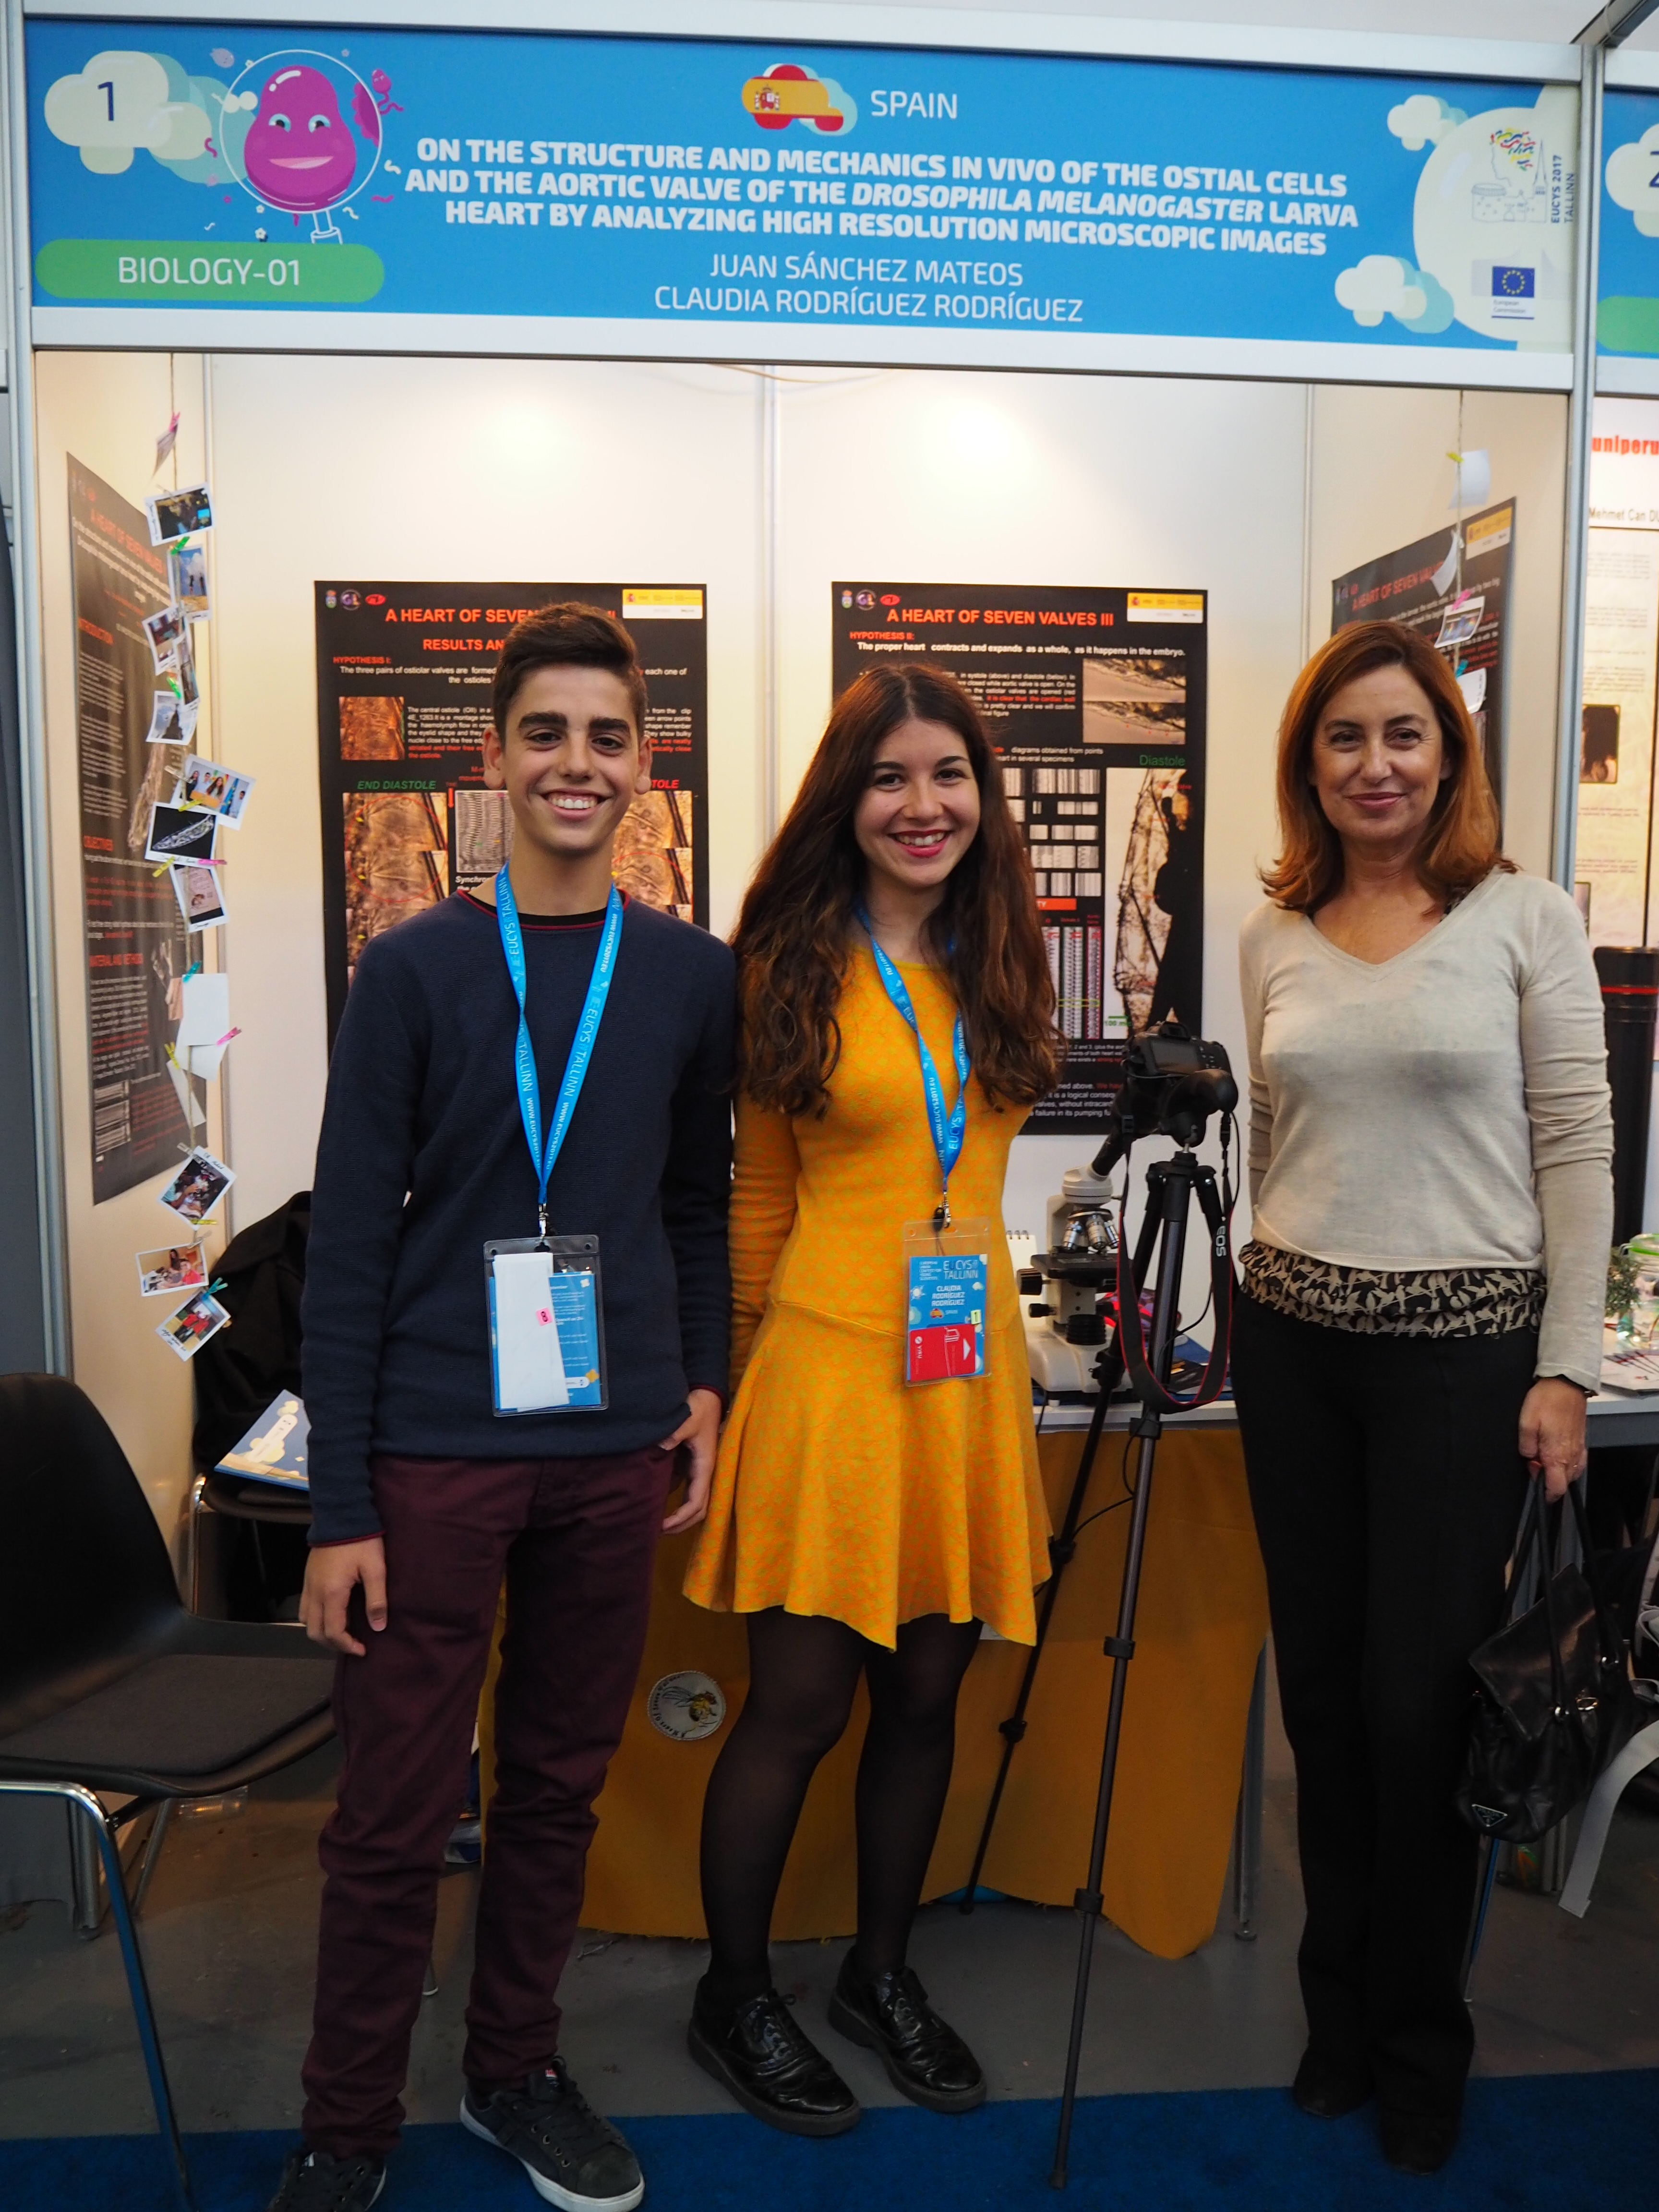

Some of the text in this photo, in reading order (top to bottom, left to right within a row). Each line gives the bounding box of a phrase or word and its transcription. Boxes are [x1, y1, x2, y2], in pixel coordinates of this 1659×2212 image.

[96, 81, 116, 122] 1
[871, 91, 957, 119] SPAIN
[418, 138, 1346, 197] ON THE STRUCTURE AND MECHANICS IN VIVO OF THE OSTIAL CELLS
[405, 169, 1358, 227] AND THE AORTIC VALVE OF THE DROSOPHILA MELANOGASTER LARVA
[1551, 155, 1562, 223] EUCYS 2017
[1564, 172, 1575, 223] TALLINN
[446, 201, 1326, 255] HEART BY ANALYZING HIGH RESOLUTION MICROSCOPIC IMAGES
[118, 256, 301, 287] BIOLOGY-01
[710, 251, 1022, 286] JUAN SÁNCHEZ MATEOS
[655, 287, 1082, 321] CLAUDIA RODRÍGUEZ RODRÍGUEZ
[1592, 435, 1659, 455] uniperu
[1628, 509, 1645, 521] Can
[385, 609, 397, 622] A
[401, 608, 455, 623] HEART
[459, 609, 481, 623] OF
[886, 609, 1114, 626] A HEART OF SEVEN VALVES III
[423, 639, 505, 651] RESULTS AN
[849, 631, 905, 640] HYPOTHESIS
[857, 642, 874, 651] The
[875, 643, 903, 652] proper
[903, 643, 926, 651] heart
[931, 644, 970, 652] contracts
[971, 644, 987, 652] and
[987, 644, 1023, 654] expands
[1044, 645, 1071, 655] whole,
[1086, 646, 1092, 654] it
[1093, 646, 1128, 656] happens
[1129, 647, 1138, 655] in
[1139, 647, 1152, 655] the
[1153, 648, 1186, 658] embryo.
[333, 656, 385, 664] HYPOTHESIS
[340, 666, 354, 674] The
[355, 666, 374, 674] three
[375, 666, 394, 675] pairs
[395, 666, 403, 674] of
[431, 666, 455, 674] valves
[471, 666, 497, 674] formed
[1011, 746, 1041, 755] diagrams
[1139, 754, 1186, 766] Diastole
[357, 780, 437, 790] END DIASTOLE
[651, 779, 680, 789] TOLE
[498, 877, 520, 955] EUCYS TALLINN
[564, 1008, 599, 1097] EUCYS TALLINN
[517, 1043, 533, 1093] TALLINN
[948, 1117, 962, 1150] EUCYS
[1215, 1225, 1227, 1257] EOS
